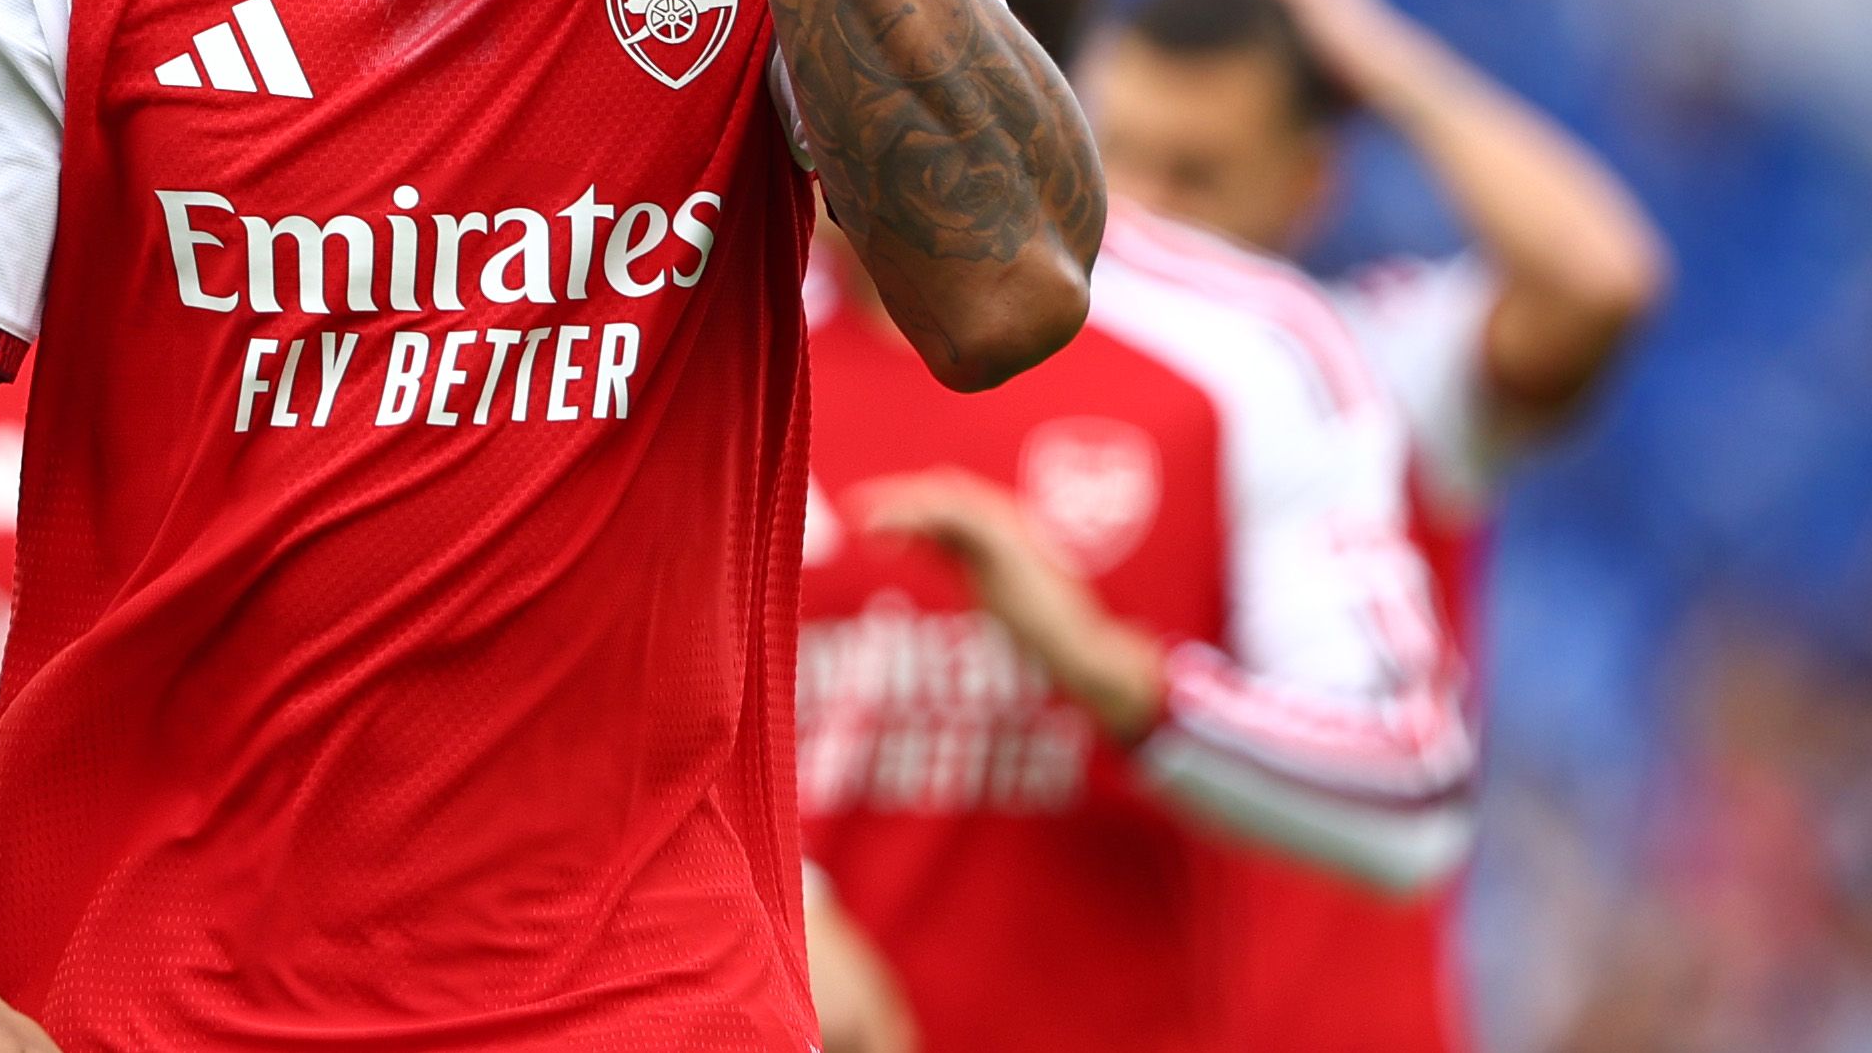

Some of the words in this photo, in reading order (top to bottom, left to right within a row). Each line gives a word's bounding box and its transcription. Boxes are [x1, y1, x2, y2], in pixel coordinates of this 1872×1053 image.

[154, 183, 721, 314] Emirates
[234, 332, 359, 433] FLY
[374, 323, 639, 427] BETTER
